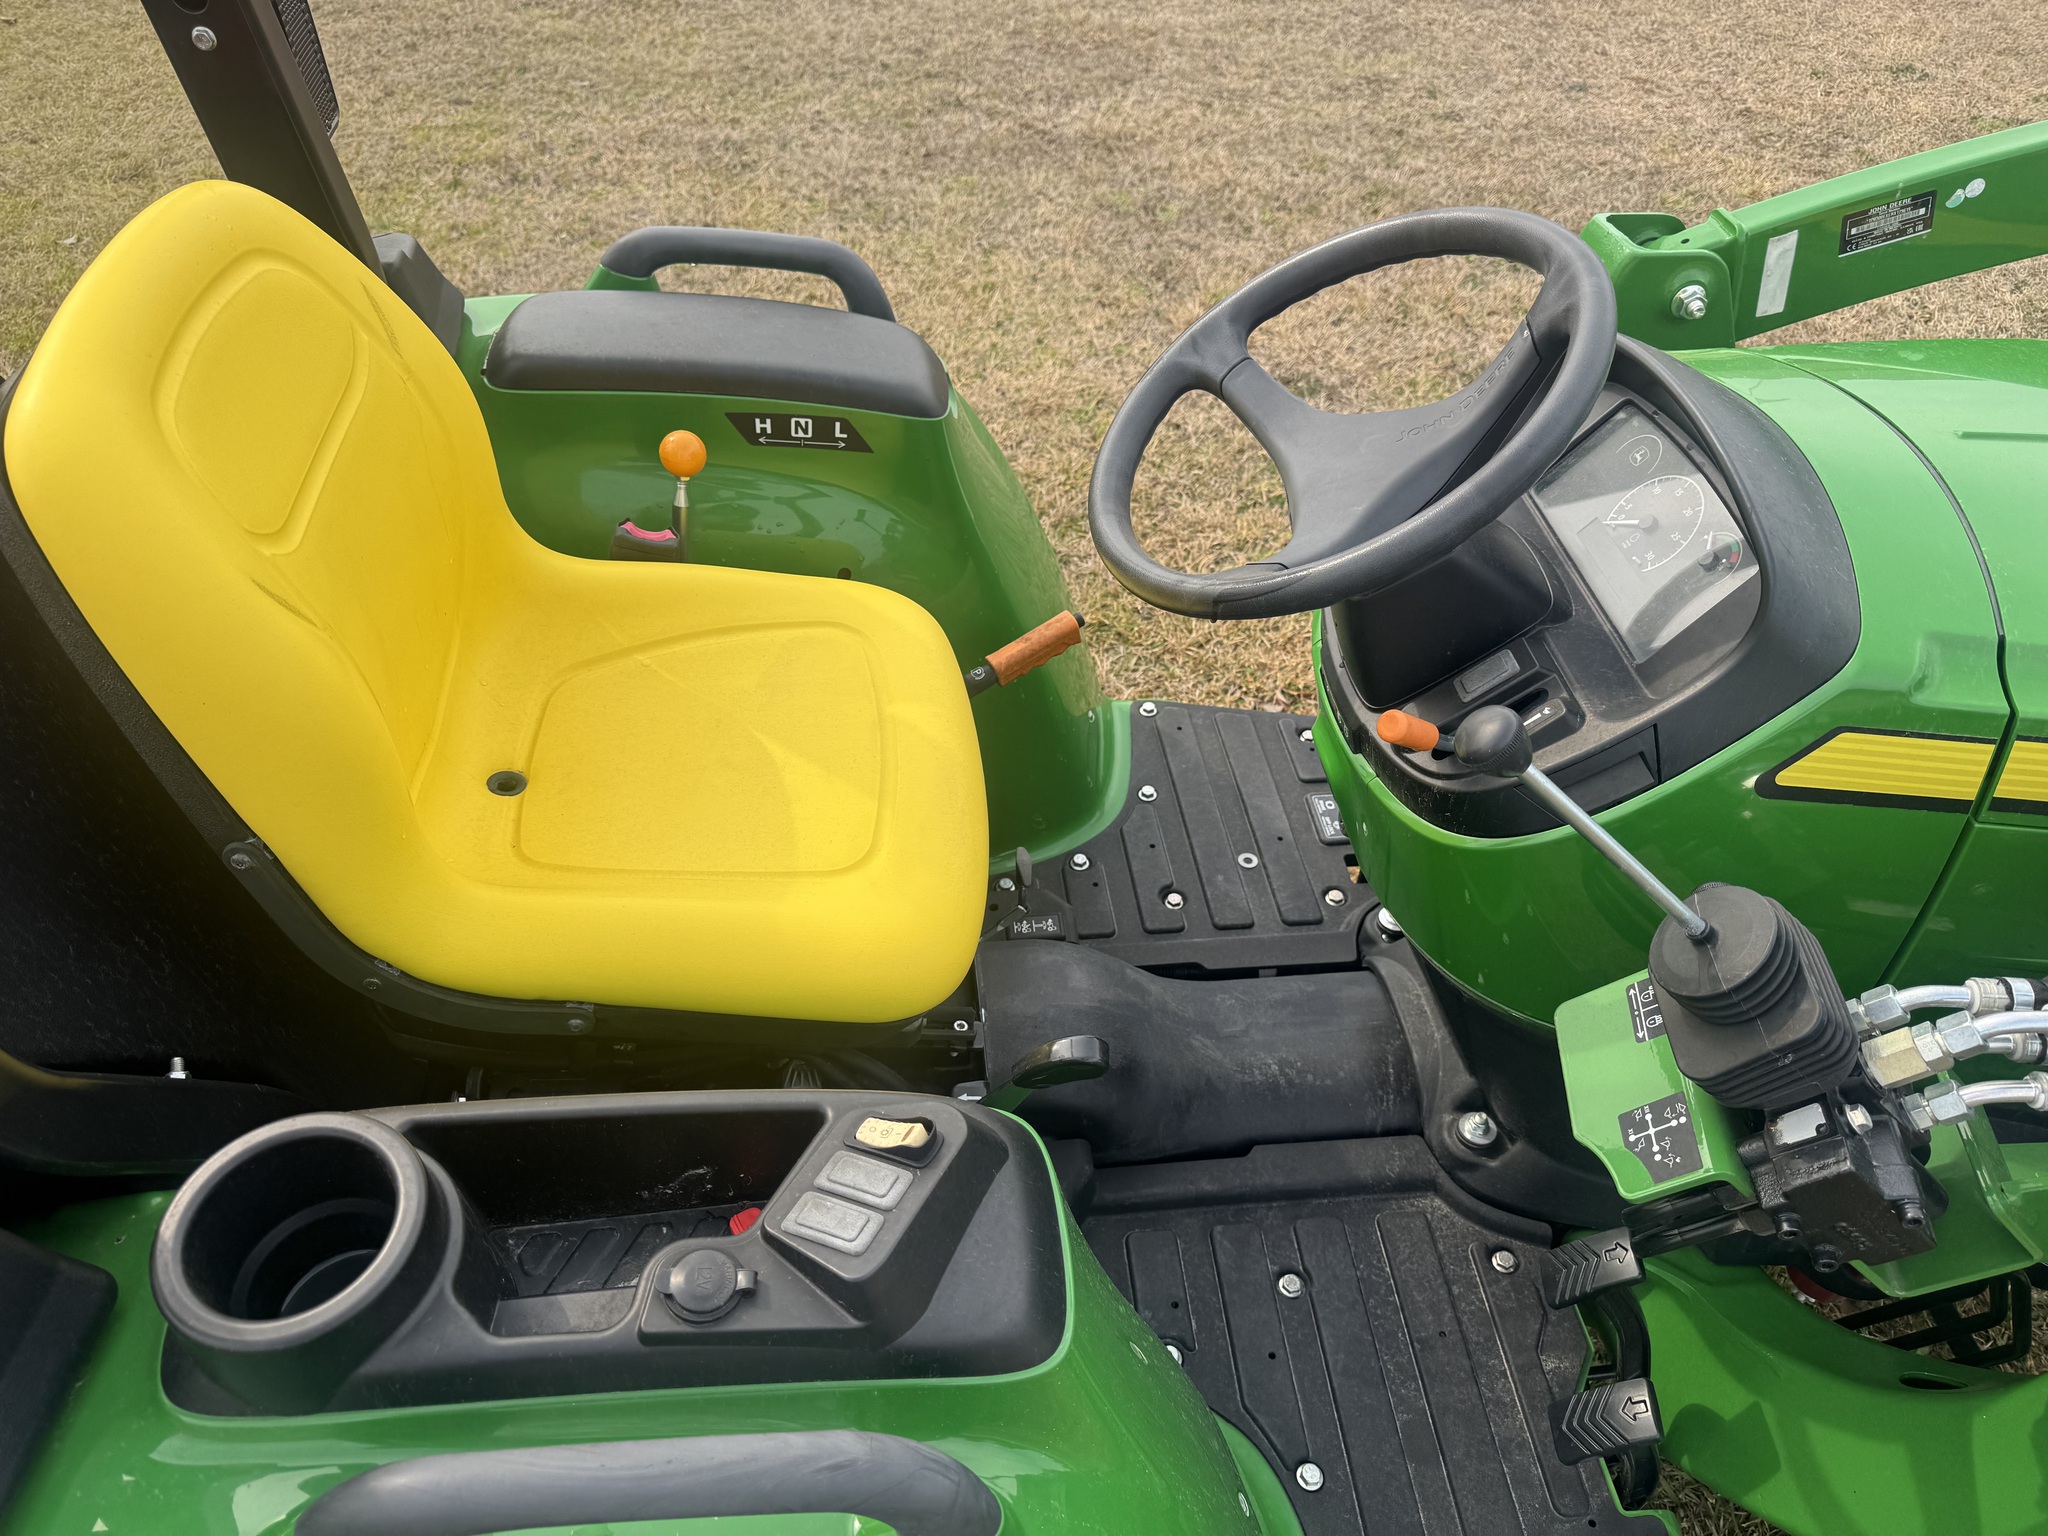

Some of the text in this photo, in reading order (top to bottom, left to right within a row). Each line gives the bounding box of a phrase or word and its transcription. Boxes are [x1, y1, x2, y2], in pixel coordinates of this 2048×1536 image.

[1869, 205, 1887, 214] JOHN
[1889, 198, 1912, 209] DEERE
[1396, 346, 1515, 442] JOHN DEERE
[754, 418, 848, 438] H N L
[1652, 486, 1662, 495] 10
[1674, 488, 1684, 497] 15
[1682, 507, 1694, 517] 20
[1670, 531, 1681, 541] 25
[1644, 551, 1655, 561] 30
[695, 1267, 712, 1290] 12V
